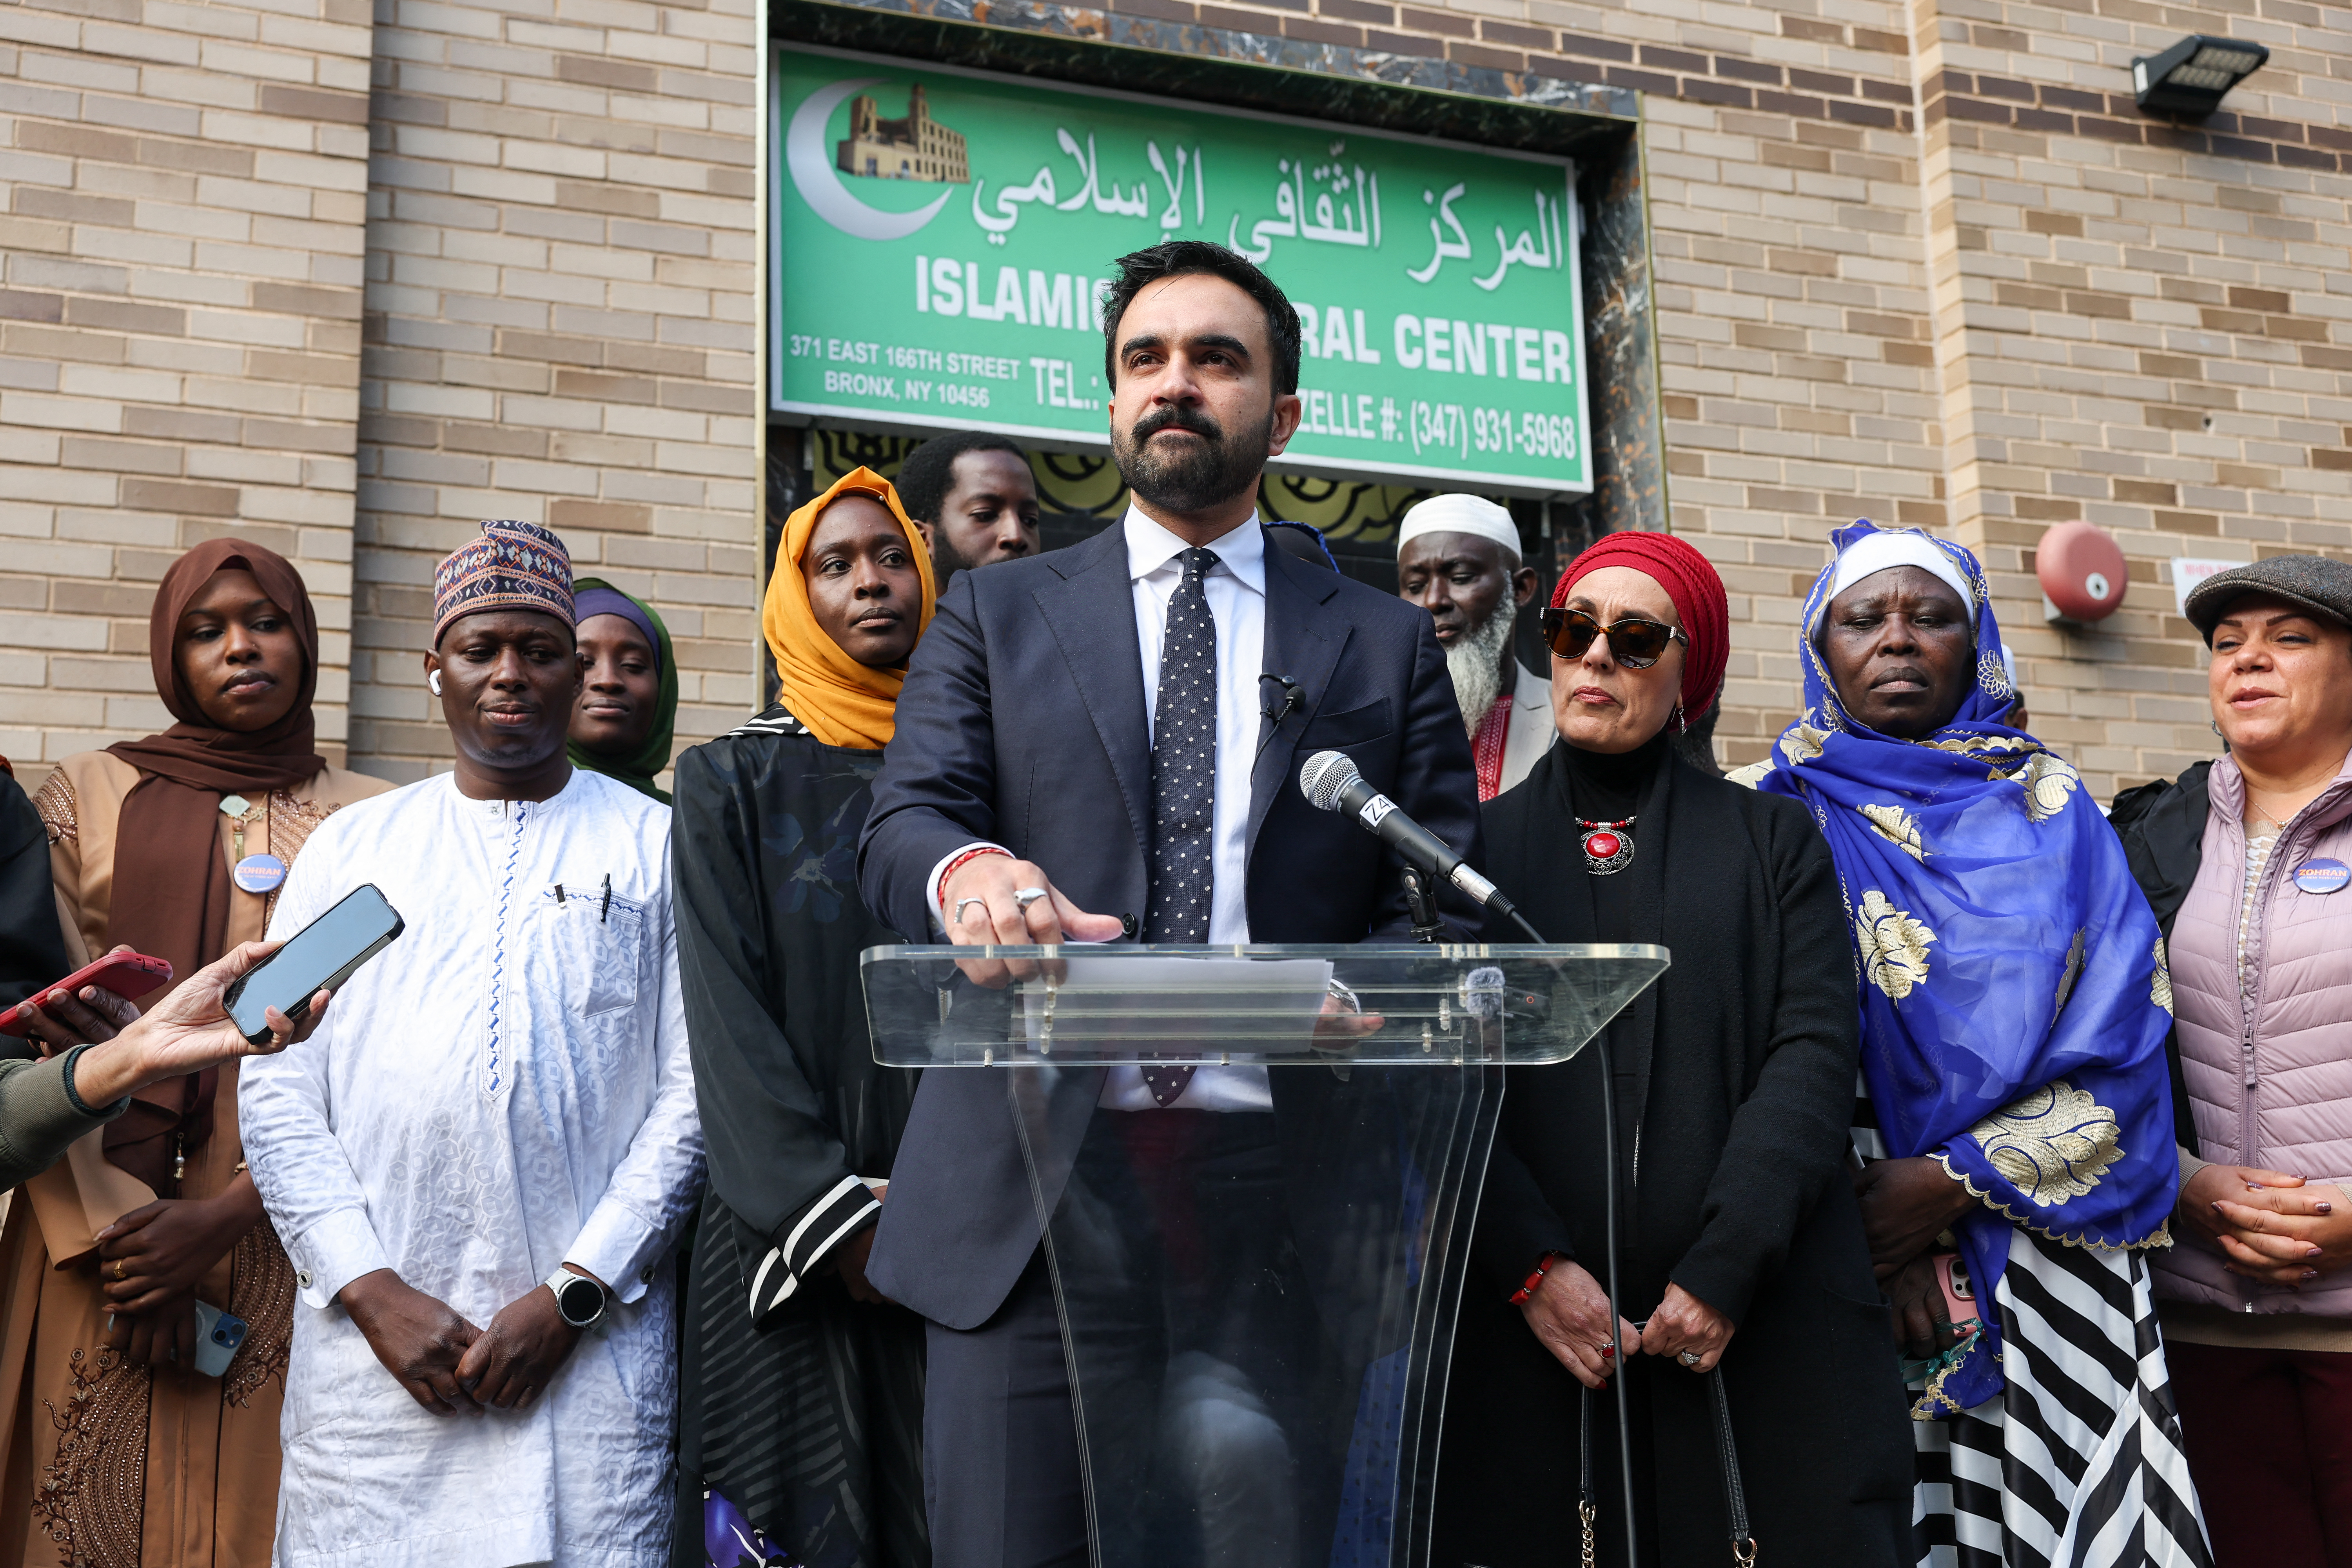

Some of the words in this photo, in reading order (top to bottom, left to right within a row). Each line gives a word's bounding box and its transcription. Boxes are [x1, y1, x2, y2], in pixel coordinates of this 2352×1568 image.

[972, 127, 1205, 246] الإسلامي
[1406, 182, 1563, 291] المركز
[789, 334, 821, 359] 371
[827, 338, 880, 365] EAST
[886, 346, 942, 372] 166TH
[947, 352, 1021, 380] STREET
[1292, 301, 1381, 365] RAL
[1394, 313, 1572, 385] CENTER
[824, 370, 901, 403] BRONX,
[905, 379, 932, 402] NY
[937, 383, 991, 408] 10456
[1029, 357, 1099, 411] TEL.:
[1296, 388, 1376, 439] ZELLE
[1379, 396, 1404, 443] #:
[1410, 399, 1468, 461] (347)
[1472, 406, 1577, 461] 931-5968
[1341, 788, 1350, 799] SM58
[238, 866, 281, 875] ZOHRAN
